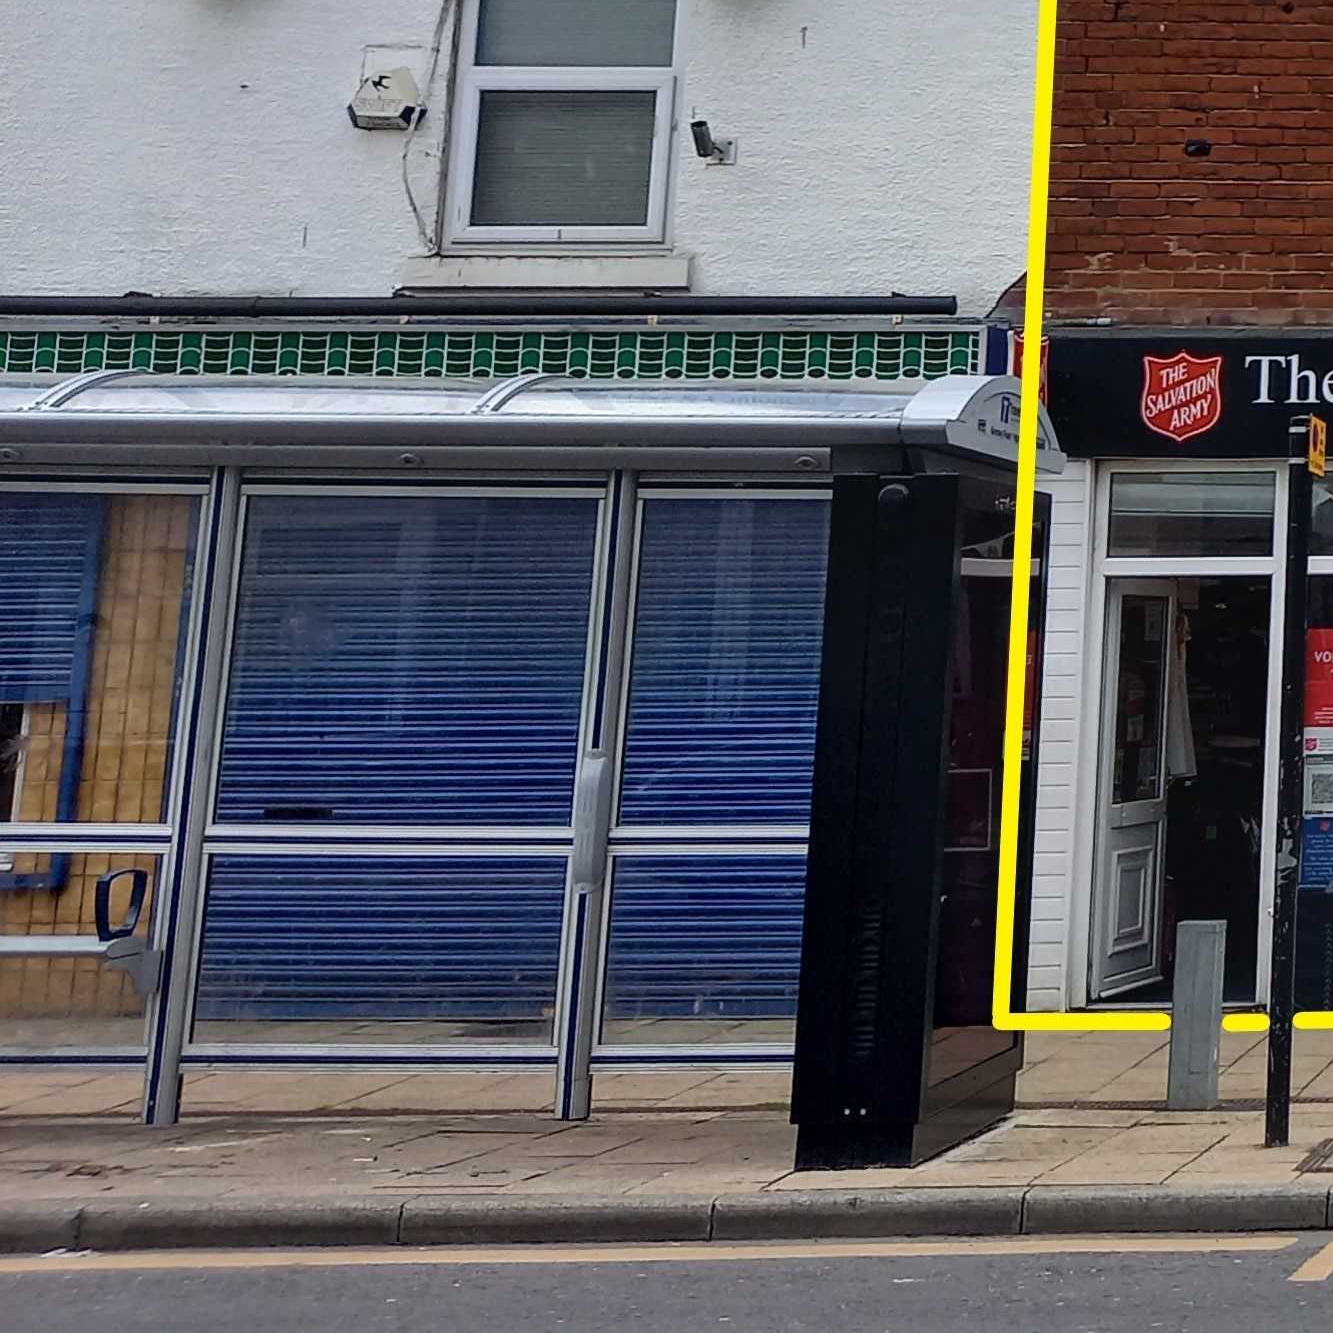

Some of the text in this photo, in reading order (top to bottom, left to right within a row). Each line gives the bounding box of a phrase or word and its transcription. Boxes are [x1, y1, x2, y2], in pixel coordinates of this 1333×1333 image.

[1146, 368, 1215, 418] SALVATION
[1158, 362, 1188, 388] THE
[1169, 394, 1212, 430] ARMY
